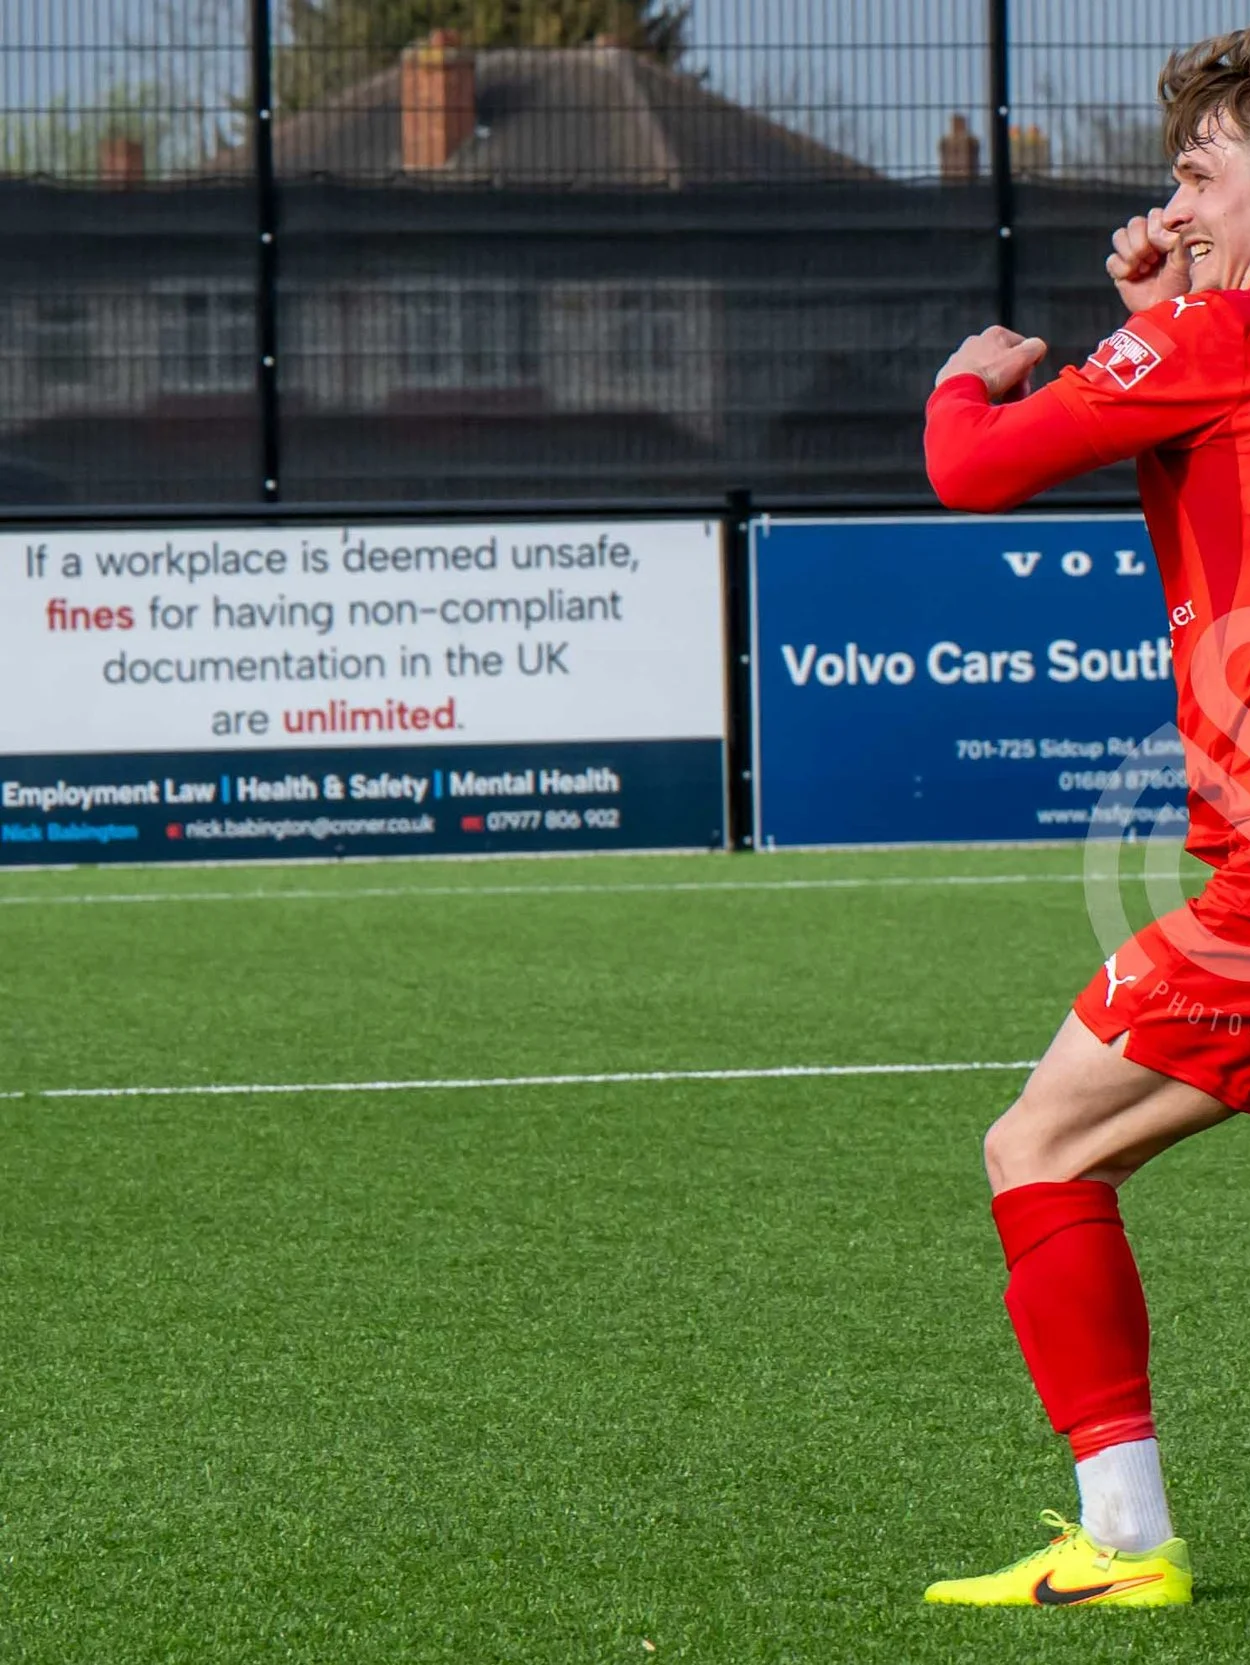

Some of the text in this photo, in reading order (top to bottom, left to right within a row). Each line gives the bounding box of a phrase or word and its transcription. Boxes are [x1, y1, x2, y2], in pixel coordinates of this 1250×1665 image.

[27, 534, 638, 583] If a workplace is deemed unsafe,
[1004, 551, 1145, 576] VOL
[46, 588, 622, 635] fines for having non-compliant
[103, 642, 569, 684] documentation in the UK
[782, 637, 1171, 685] Volvo Cars South
[212, 697, 463, 736] are unlimited.
[957, 739, 1036, 760] 701-725
[1040, 739, 1104, 759] Sidcup
[2, 779, 216, 812] Employment Law
[237, 773, 428, 803] Health & Safety
[449, 767, 620, 796] Mental Health
[483, 810, 542, 831] 07977
